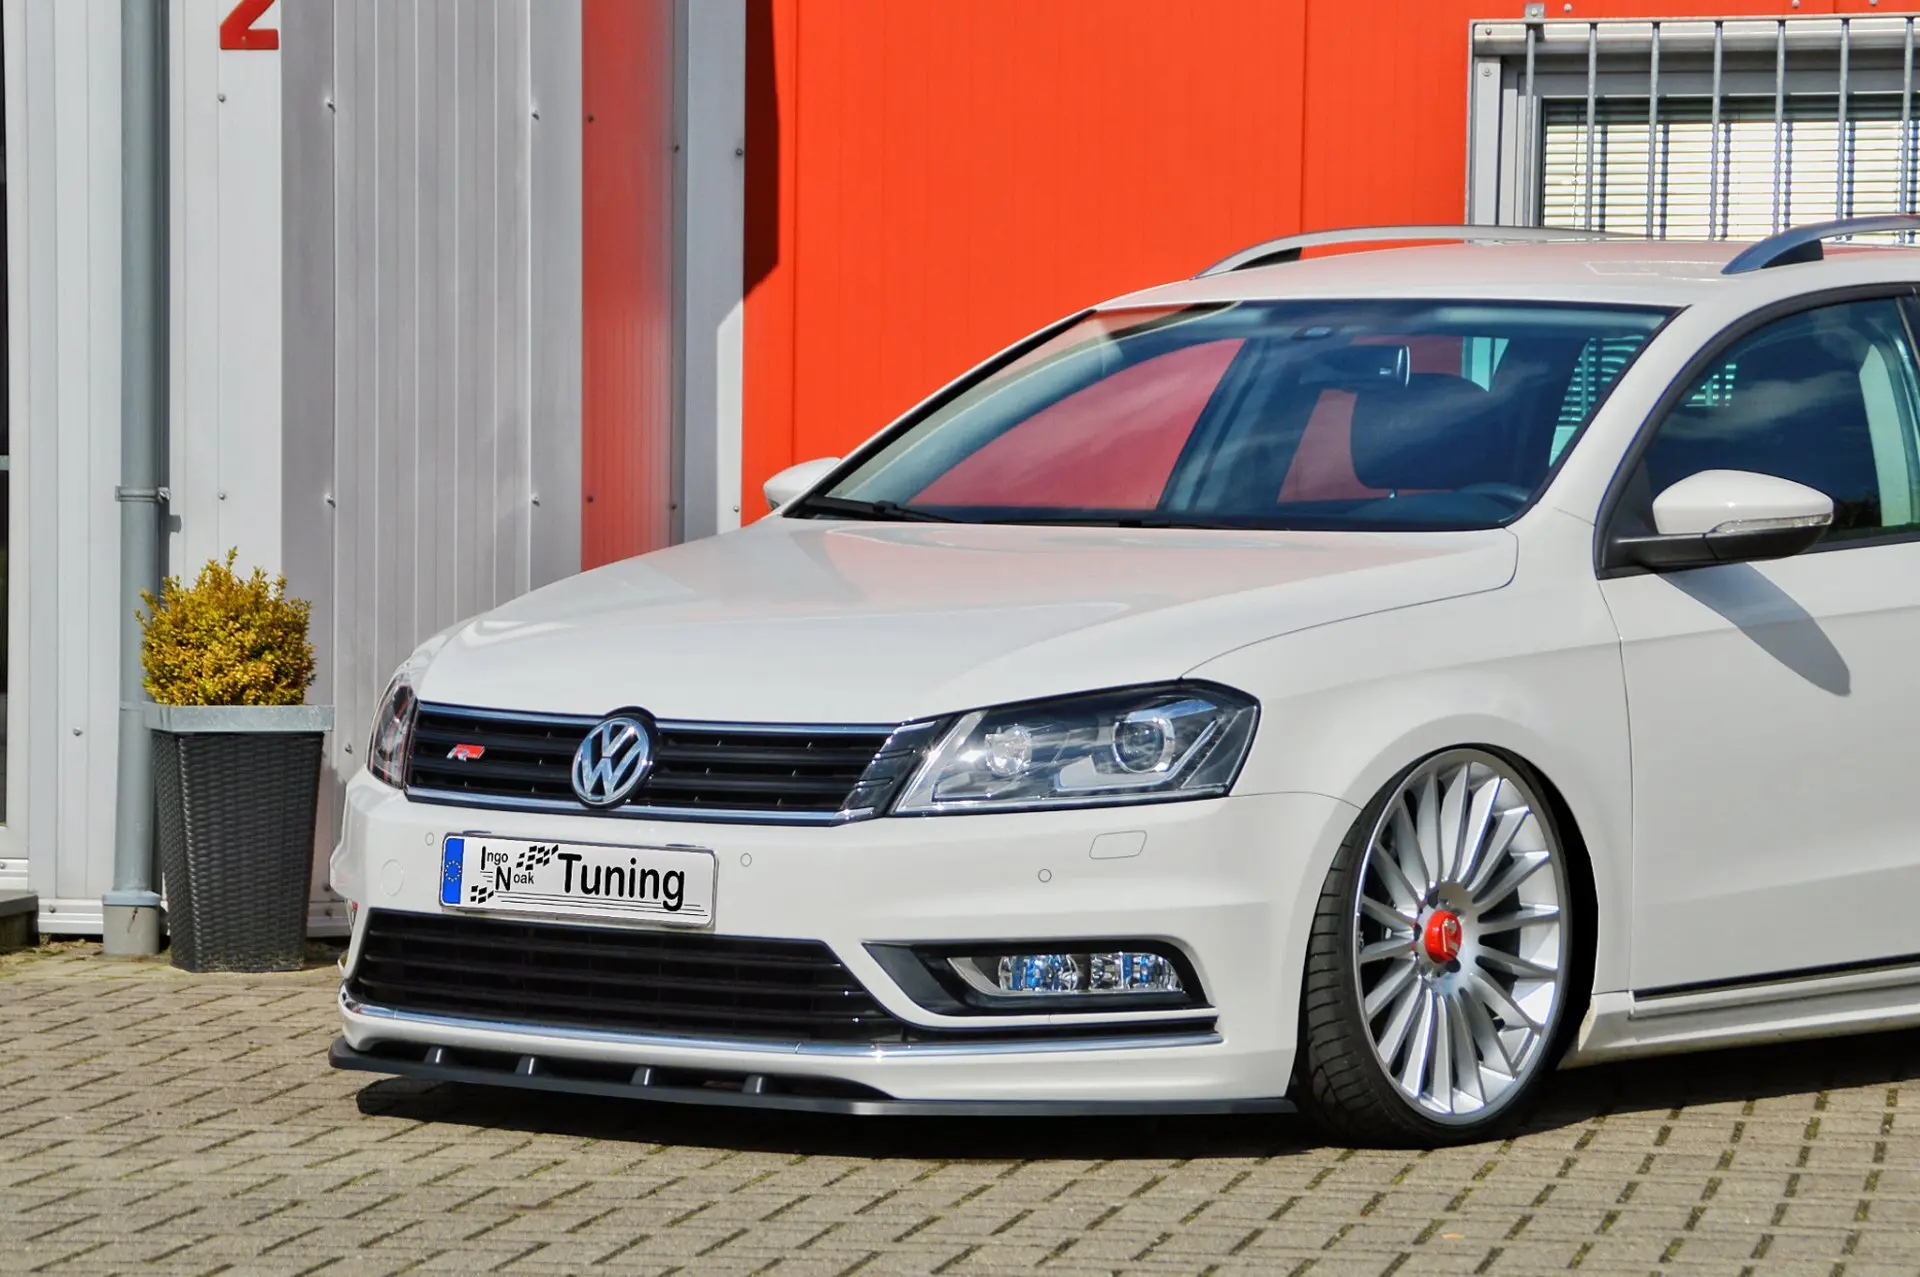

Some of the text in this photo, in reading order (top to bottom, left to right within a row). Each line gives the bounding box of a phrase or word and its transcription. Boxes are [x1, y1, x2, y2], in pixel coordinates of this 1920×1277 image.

[480, 846, 509, 871] Ingo
[495, 865, 534, 891] Noak
[557, 852, 685, 912] Tuning
